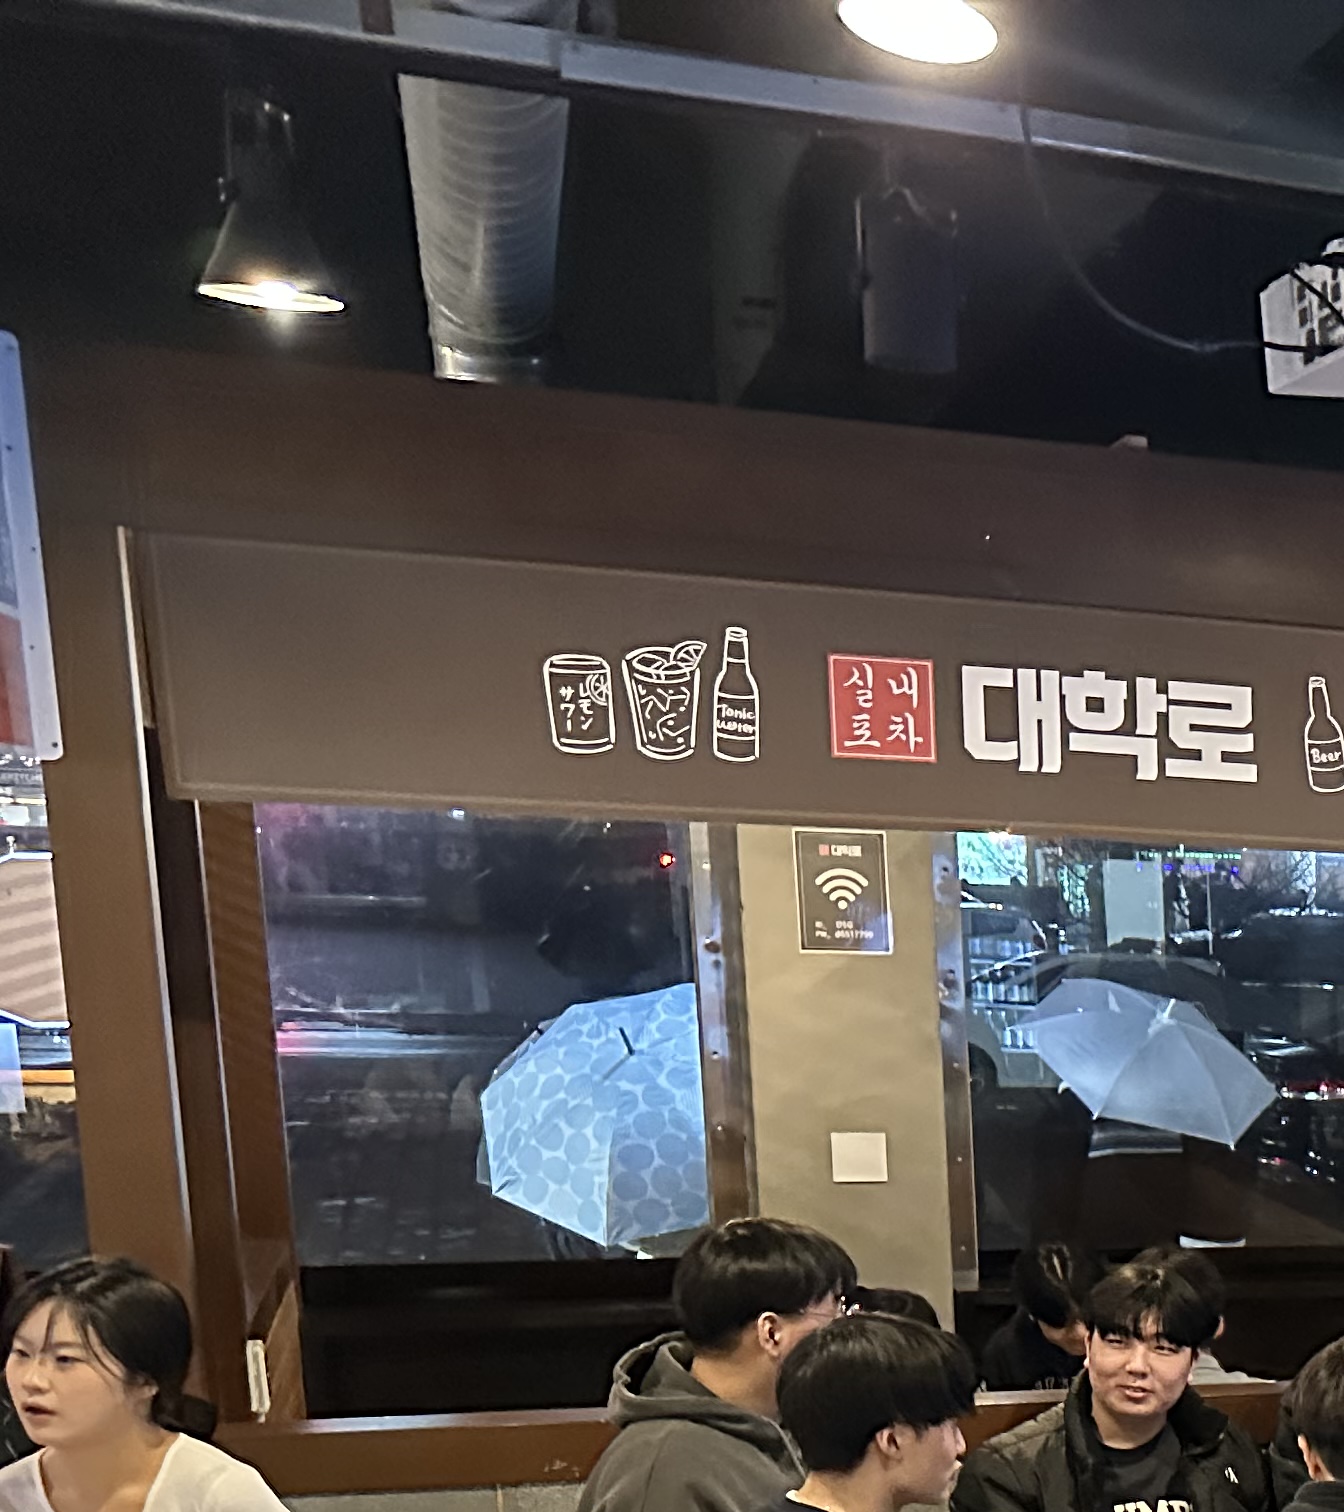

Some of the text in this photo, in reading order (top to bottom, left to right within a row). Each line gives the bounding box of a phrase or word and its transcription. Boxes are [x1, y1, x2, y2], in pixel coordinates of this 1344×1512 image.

[843, 663, 918, 709] 실내
[717, 703, 755, 720] Tonic
[844, 711, 924, 753] 포차
[961, 665, 1258, 784] 대학로
[1310, 747, 1341, 764] Beer
